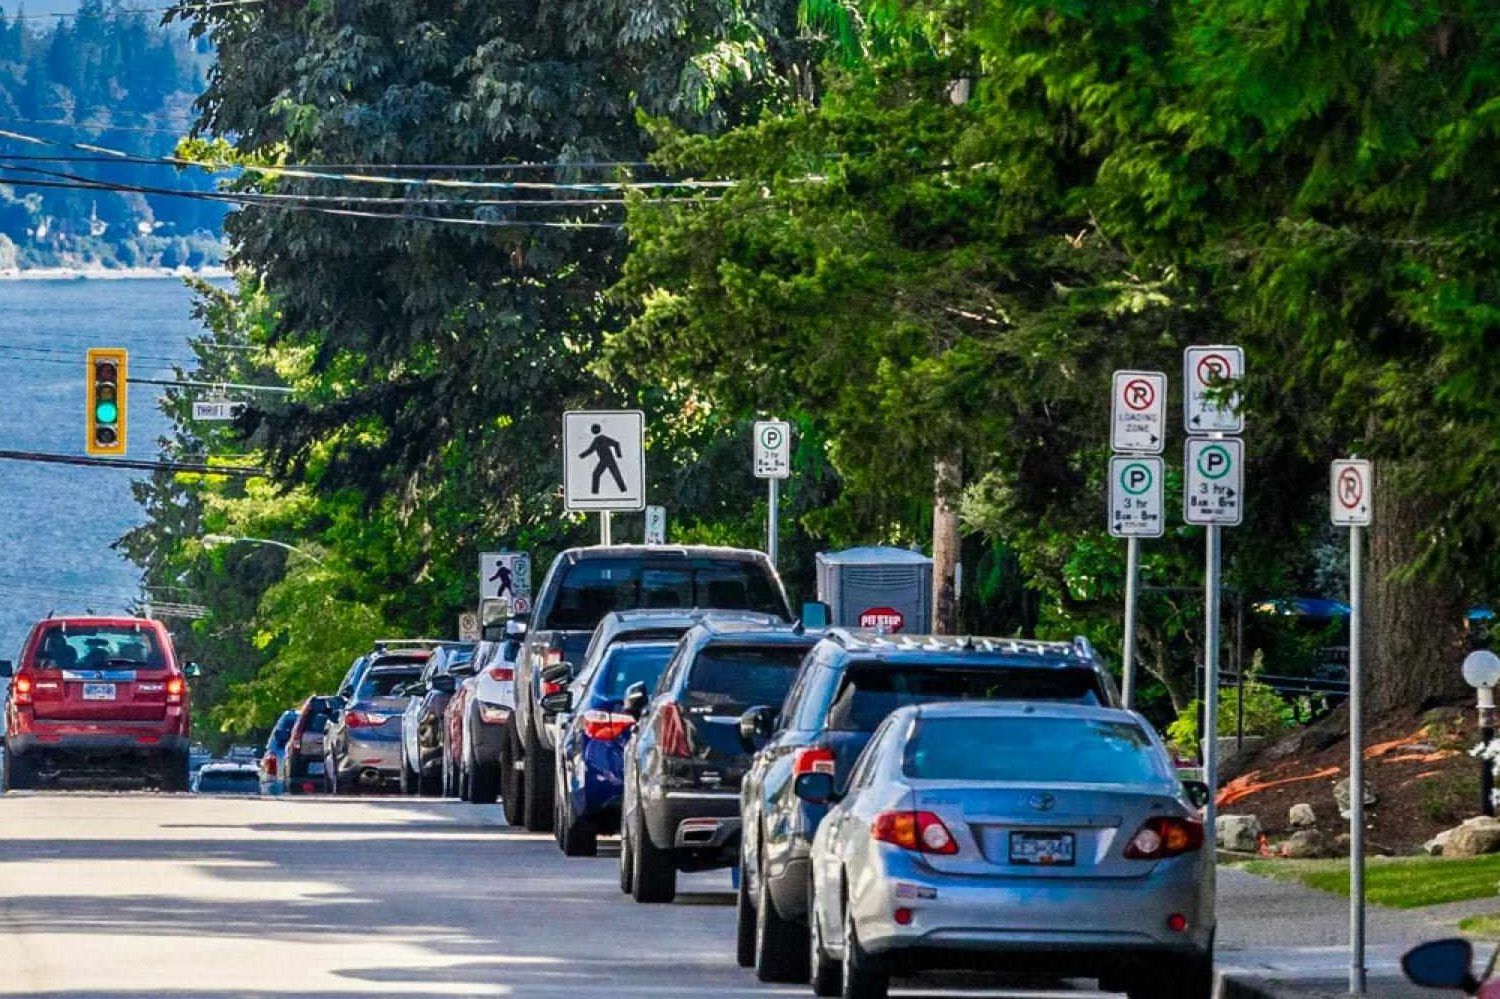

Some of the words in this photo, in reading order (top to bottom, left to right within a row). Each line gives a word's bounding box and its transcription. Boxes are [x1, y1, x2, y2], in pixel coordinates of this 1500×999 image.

[1118, 413, 1157, 423] LOADING
[1125, 424, 1149, 433] ZONE
[1207, 453, 1224, 472] P
[1130, 470, 1146, 488] P
[1199, 483, 1209, 495] 3
[1123, 498, 1132, 509] 3
[1136, 498, 1148, 509] hr
